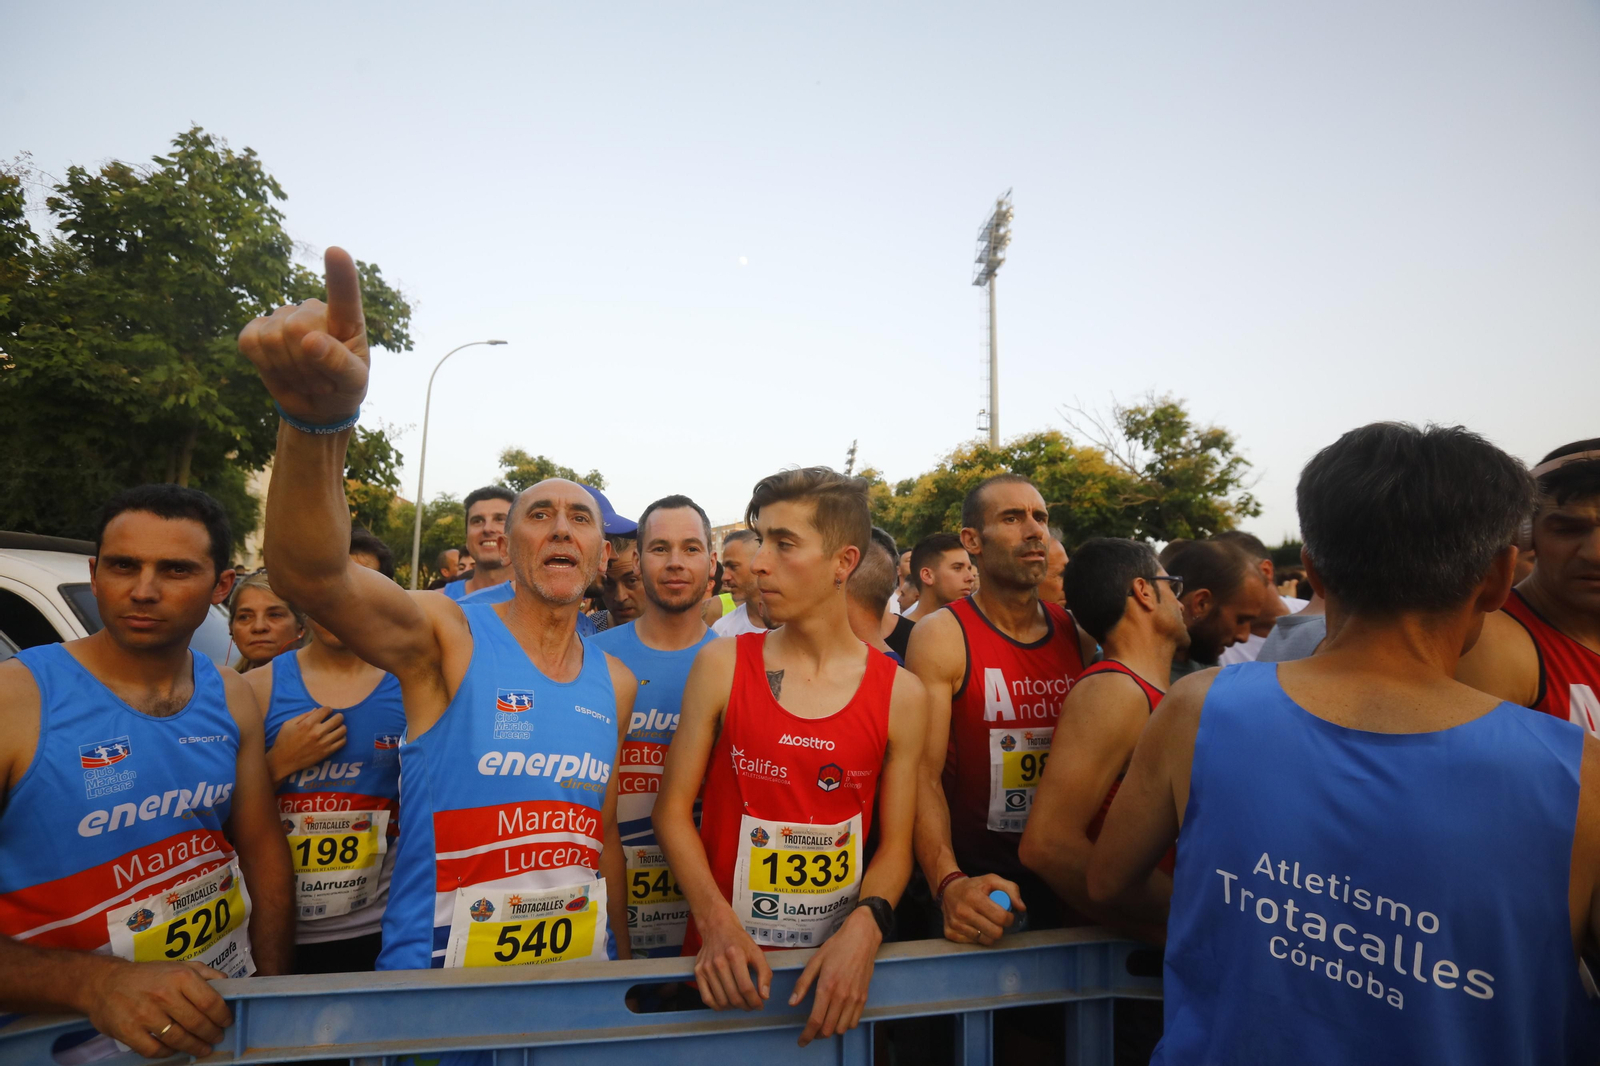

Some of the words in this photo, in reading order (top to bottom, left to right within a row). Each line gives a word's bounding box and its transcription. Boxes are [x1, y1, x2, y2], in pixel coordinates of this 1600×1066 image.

[495, 712, 519, 722] Club
[495, 721, 534, 731] Maratón
[494, 730, 530, 740] Lucena
[778, 733, 835, 751] Mosttro
[622, 745, 668, 765] rató
[84, 766, 115, 780] Club
[477, 750, 612, 785] enerplus
[740, 757, 788, 779] califas
[85, 769, 137, 790] Maratón
[87, 780, 135, 799] Lucena
[78, 781, 233, 837] enerplus
[307, 821, 350, 831] TROTACALLES
[498, 807, 598, 837] Maratón
[784, 835, 832, 846] TROTACALLES
[296, 836, 359, 867] 198
[504, 847, 592, 873] Lucena
[763, 850, 849, 887] 1333
[301, 876, 367, 892] laArruzafa
[1252, 852, 1440, 935] Atletismo
[172, 883, 217, 911] TROTACALLES
[511, 900, 564, 915] TROTACALLES
[784, 896, 849, 915] laArruzafa
[642, 910, 690, 922] laArruza
[165, 898, 230, 959] 520
[1216, 868, 1496, 1000] Trotacalles
[494, 918, 572, 962] 540
[1269, 935, 1404, 1010] Córdoba
